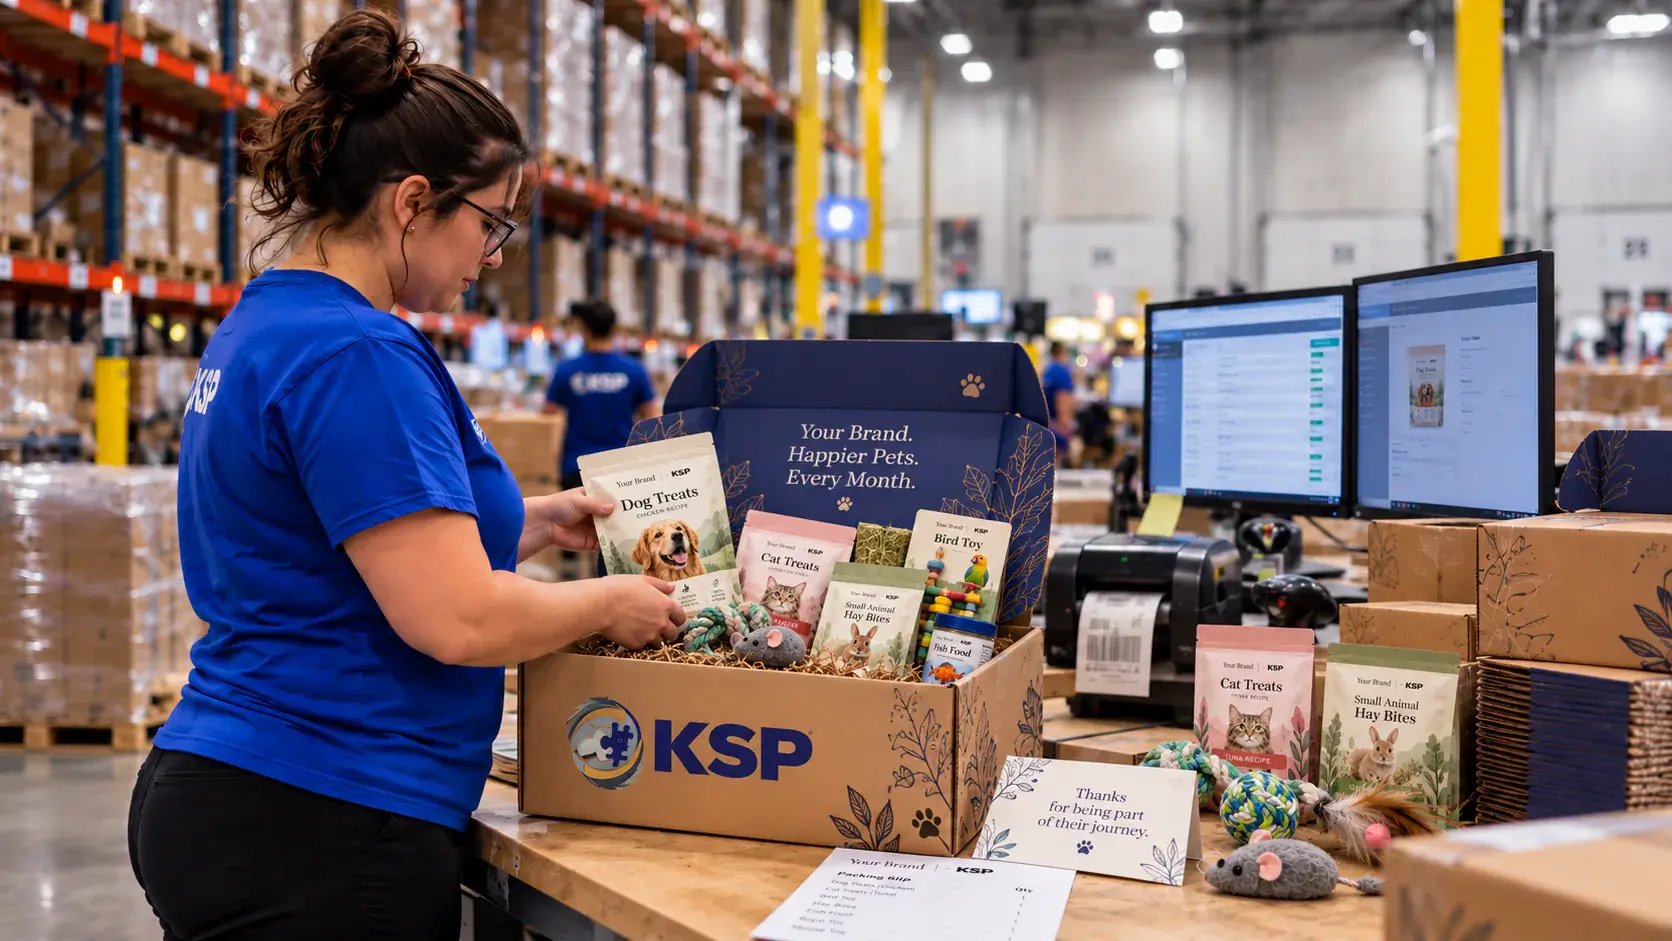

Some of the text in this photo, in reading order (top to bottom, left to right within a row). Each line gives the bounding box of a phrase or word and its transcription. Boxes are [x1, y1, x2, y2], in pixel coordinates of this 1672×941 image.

[190, 368, 221, 415] KSP
[801, 424, 912, 442] Your Brand.
[788, 446, 919, 467] Happier Pets.
[616, 468, 691, 488] Your Brand KSP
[786, 469, 915, 490] Every Month.
[620, 488, 699, 512] Dog Treats
[934, 533, 983, 551] Bird Toy
[761, 553, 820, 571] Cat Treats
[844, 610, 890, 623] Hay Bites
[867, 604, 895, 613] Animal
[934, 644, 948, 652] Fish
[950, 646, 971, 657] Food
[1220, 677, 1283, 692] Cat Treats
[1354, 695, 1419, 710] Small Animal
[1355, 707, 1416, 724] Hay Bites
[654, 719, 813, 781] KSP
[1076, 788, 1127, 803] Thanks
[1049, 801, 1144, 821] for being part
[1037, 816, 1148, 839] of their journey.
[884, 860, 926, 870] Brand
[838, 871, 884, 880] Packing
